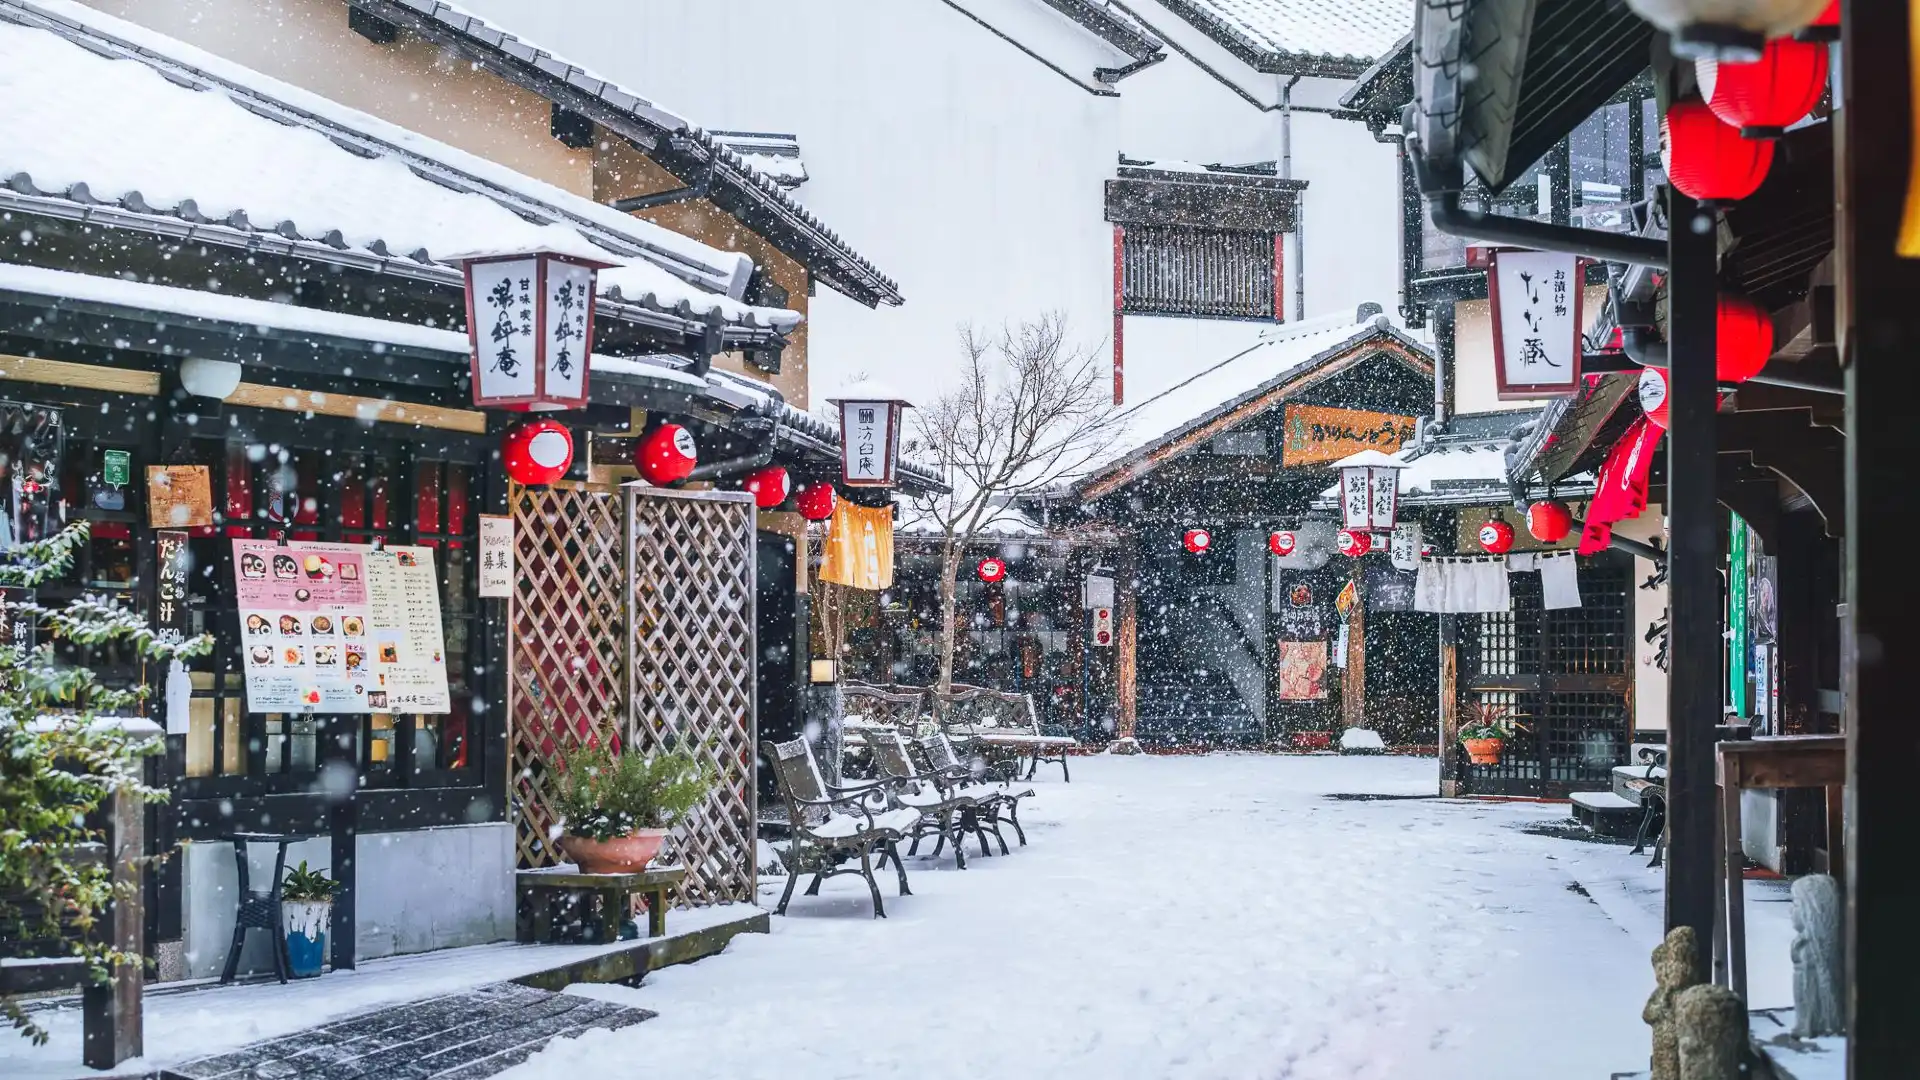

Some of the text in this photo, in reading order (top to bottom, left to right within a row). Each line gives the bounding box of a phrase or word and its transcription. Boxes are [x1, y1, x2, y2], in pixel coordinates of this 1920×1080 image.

[518, 278, 532, 337] 甘味喫茶
[1554, 269, 1567, 317] お漬け物
[160, 538, 176, 622] だんご汁
[483, 550, 508, 570] 募集
